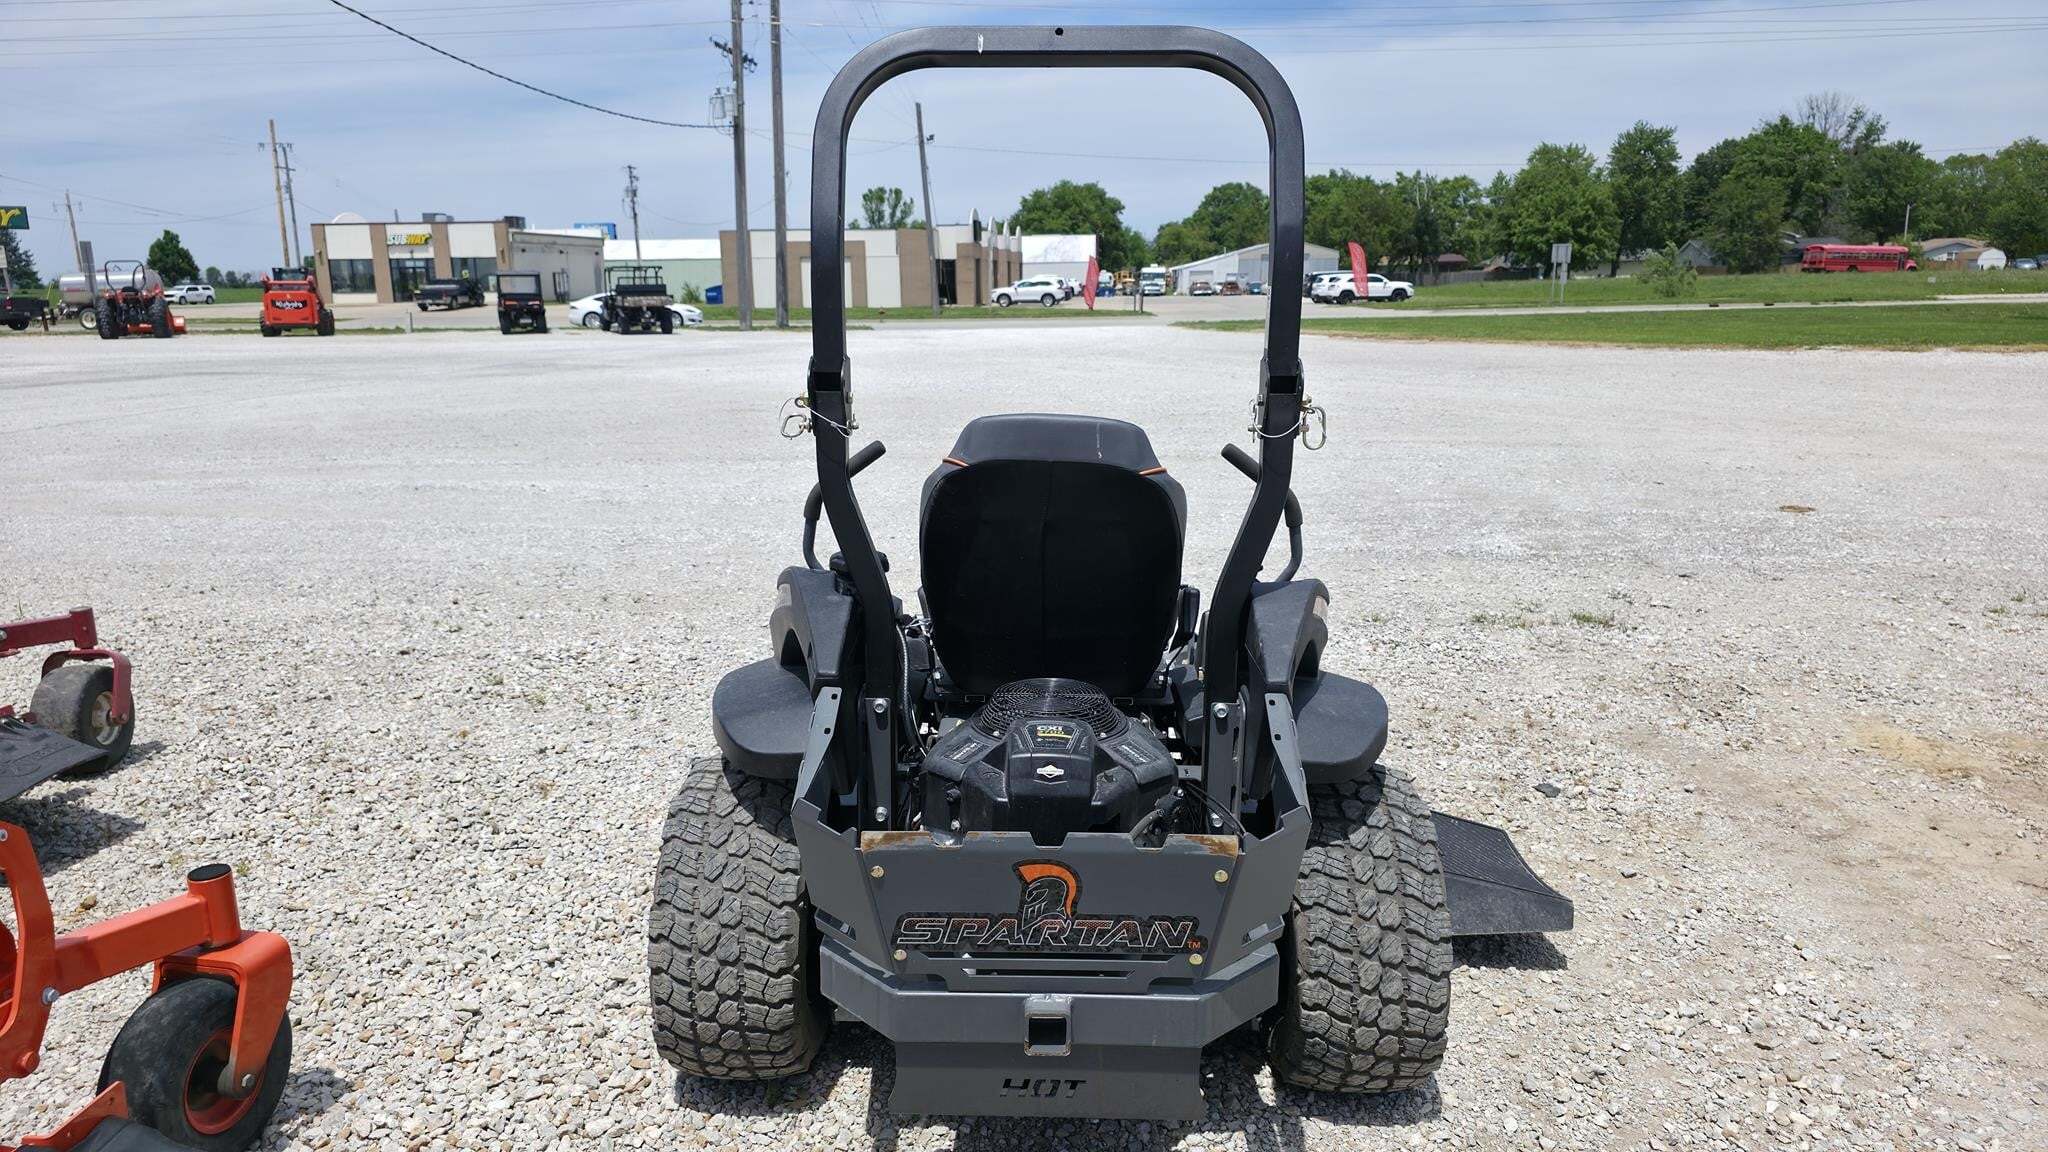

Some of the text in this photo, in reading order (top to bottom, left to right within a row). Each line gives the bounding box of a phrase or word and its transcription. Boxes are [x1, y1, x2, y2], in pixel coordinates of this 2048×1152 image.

[387, 233, 431, 245] SUBWAY
[897, 917, 1193, 948] SPARTAN
[1000, 1078, 1088, 1098] HOT
